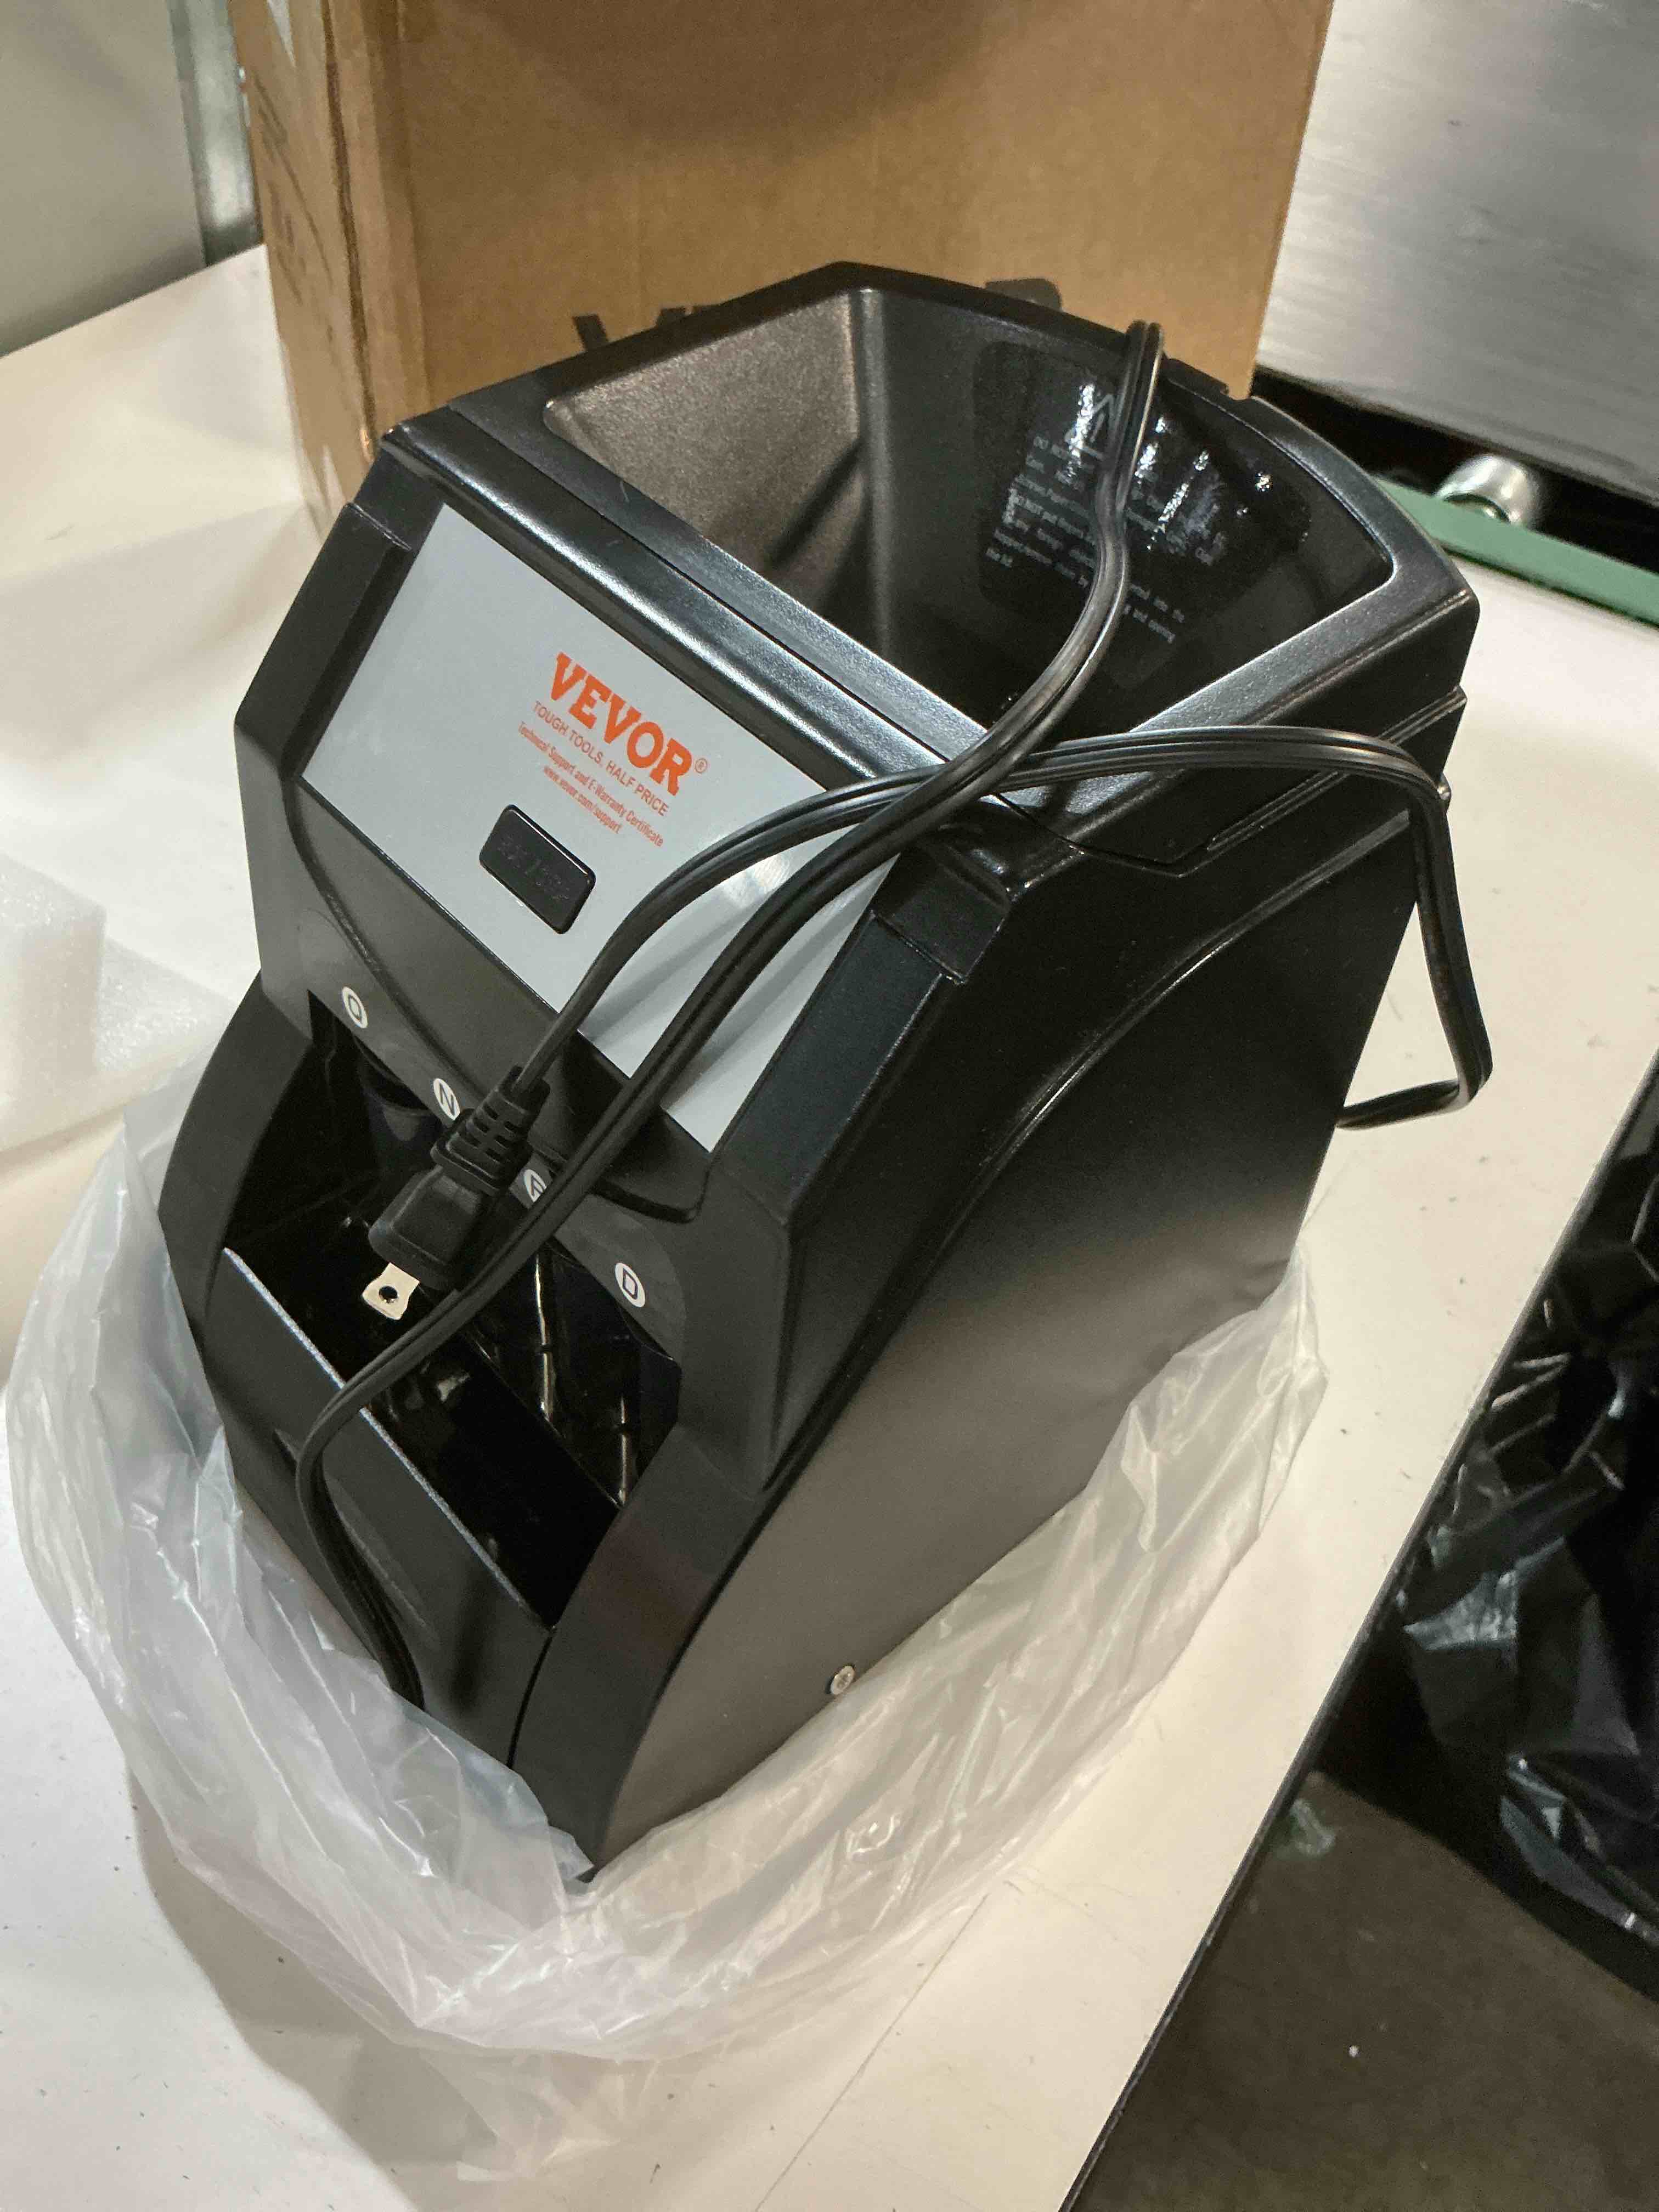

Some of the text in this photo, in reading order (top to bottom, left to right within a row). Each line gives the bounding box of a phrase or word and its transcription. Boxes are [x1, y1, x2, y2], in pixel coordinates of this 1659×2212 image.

[534, 701, 569, 736] TOUGH
[606, 760, 636, 787] HALF
[634, 783, 669, 816] PRICE
[549, 746, 575, 774] Support
[575, 771, 590, 786] and
[627, 810, 663, 847] Certificate
[439, 1083, 455, 1116] N
[623, 1268, 637, 1300] D
